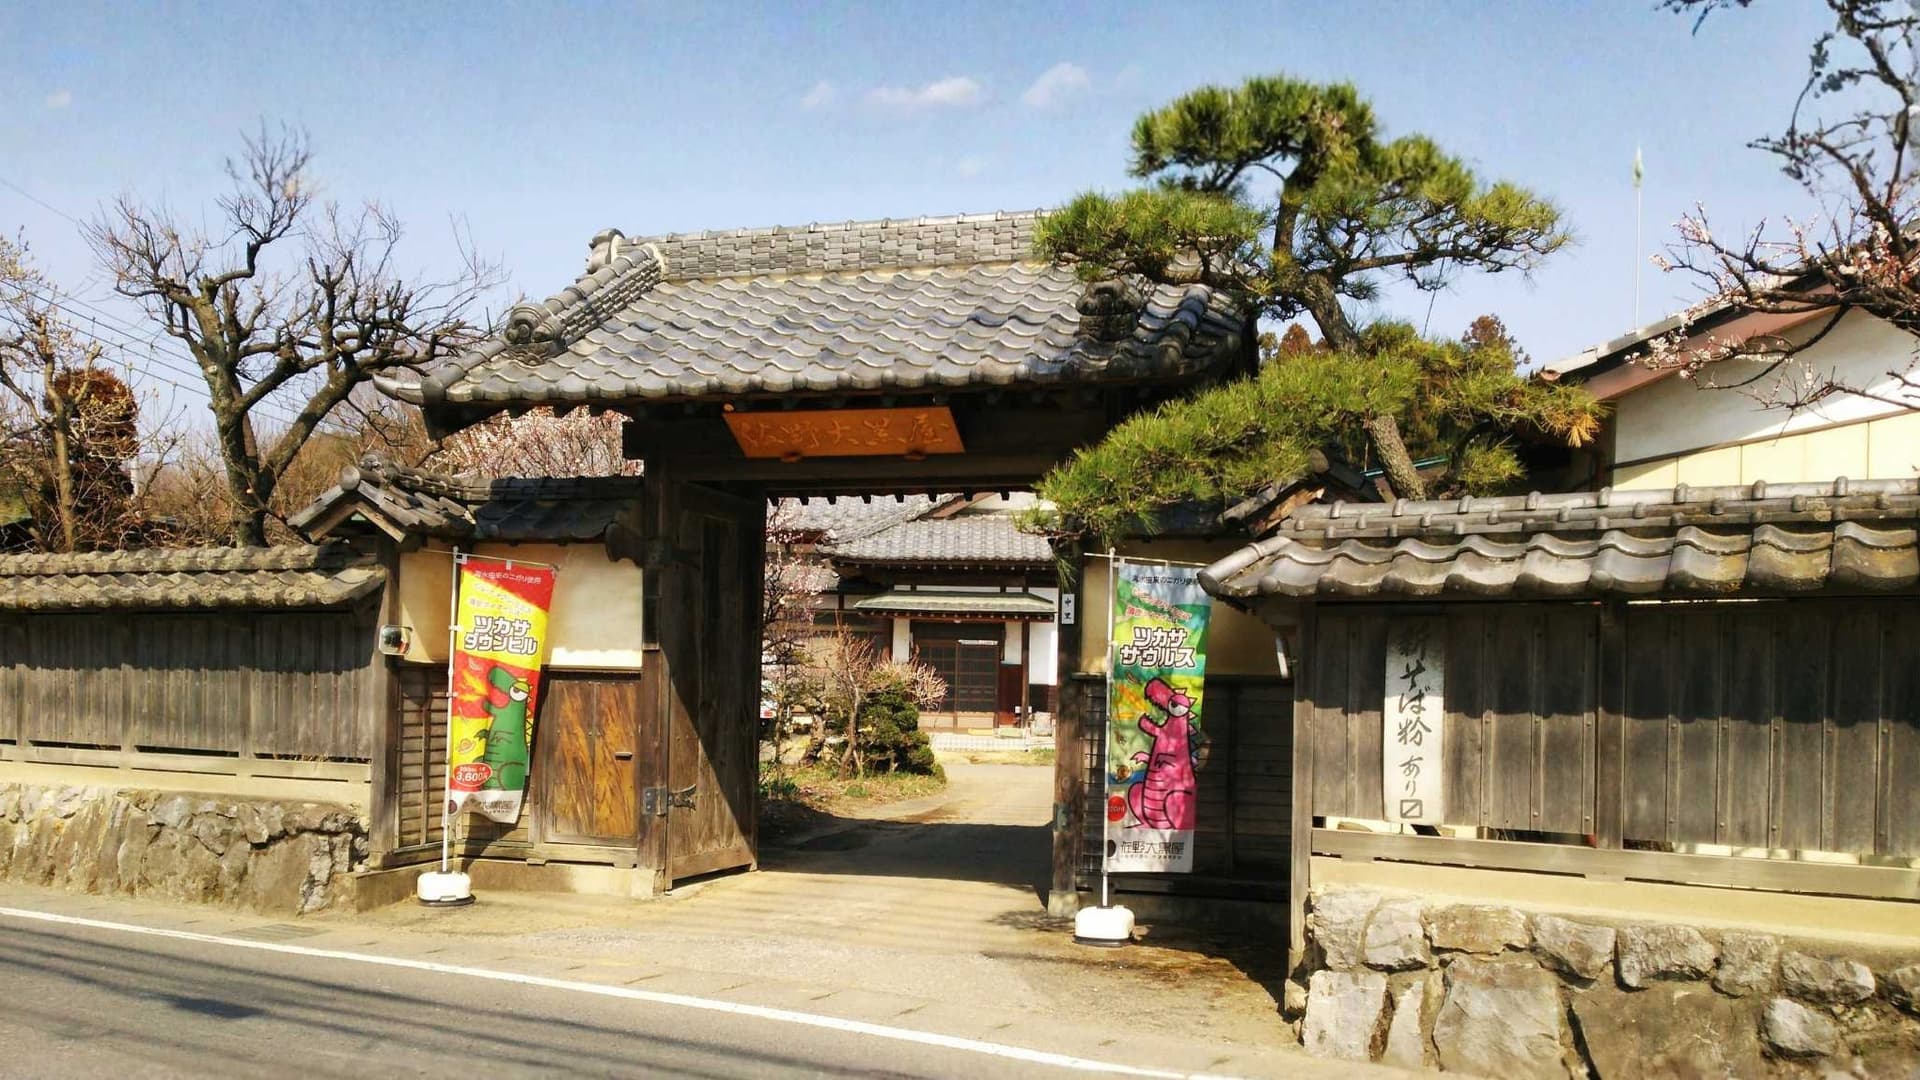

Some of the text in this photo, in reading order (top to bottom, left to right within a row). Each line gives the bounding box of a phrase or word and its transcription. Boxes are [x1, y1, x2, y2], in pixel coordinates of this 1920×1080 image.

[474, 616, 531, 637] ツカサ
[464, 632, 538, 655] ダウンヒル
[1133, 627, 1187, 650] ツカサ
[1120, 645, 1195, 667] サウルス
